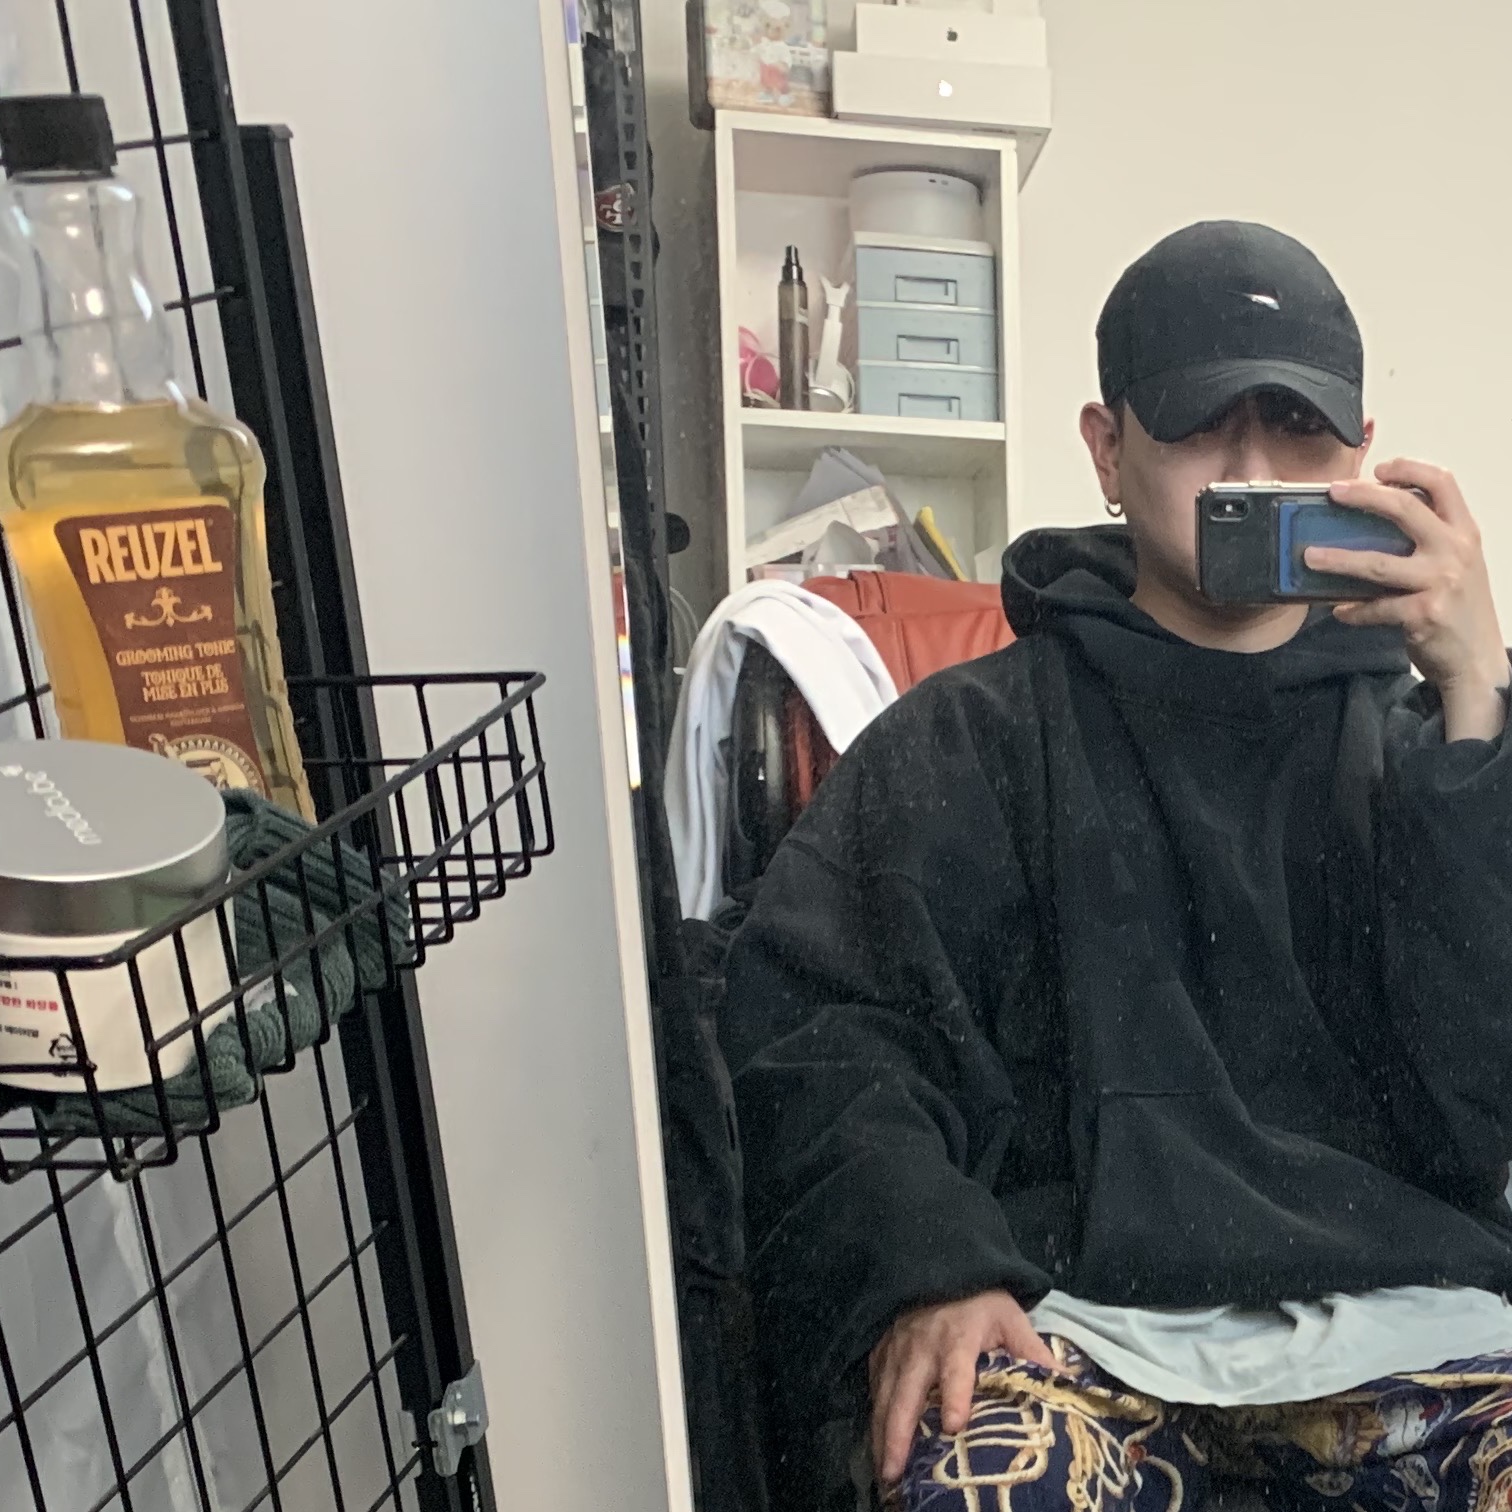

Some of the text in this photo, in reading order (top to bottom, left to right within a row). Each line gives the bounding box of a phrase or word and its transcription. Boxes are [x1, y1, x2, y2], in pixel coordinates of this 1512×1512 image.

[78, 518, 223, 584] REUZEL
[116, 639, 236, 666] GROOMING TONIC
[141, 666, 204, 687] TONIQUE
